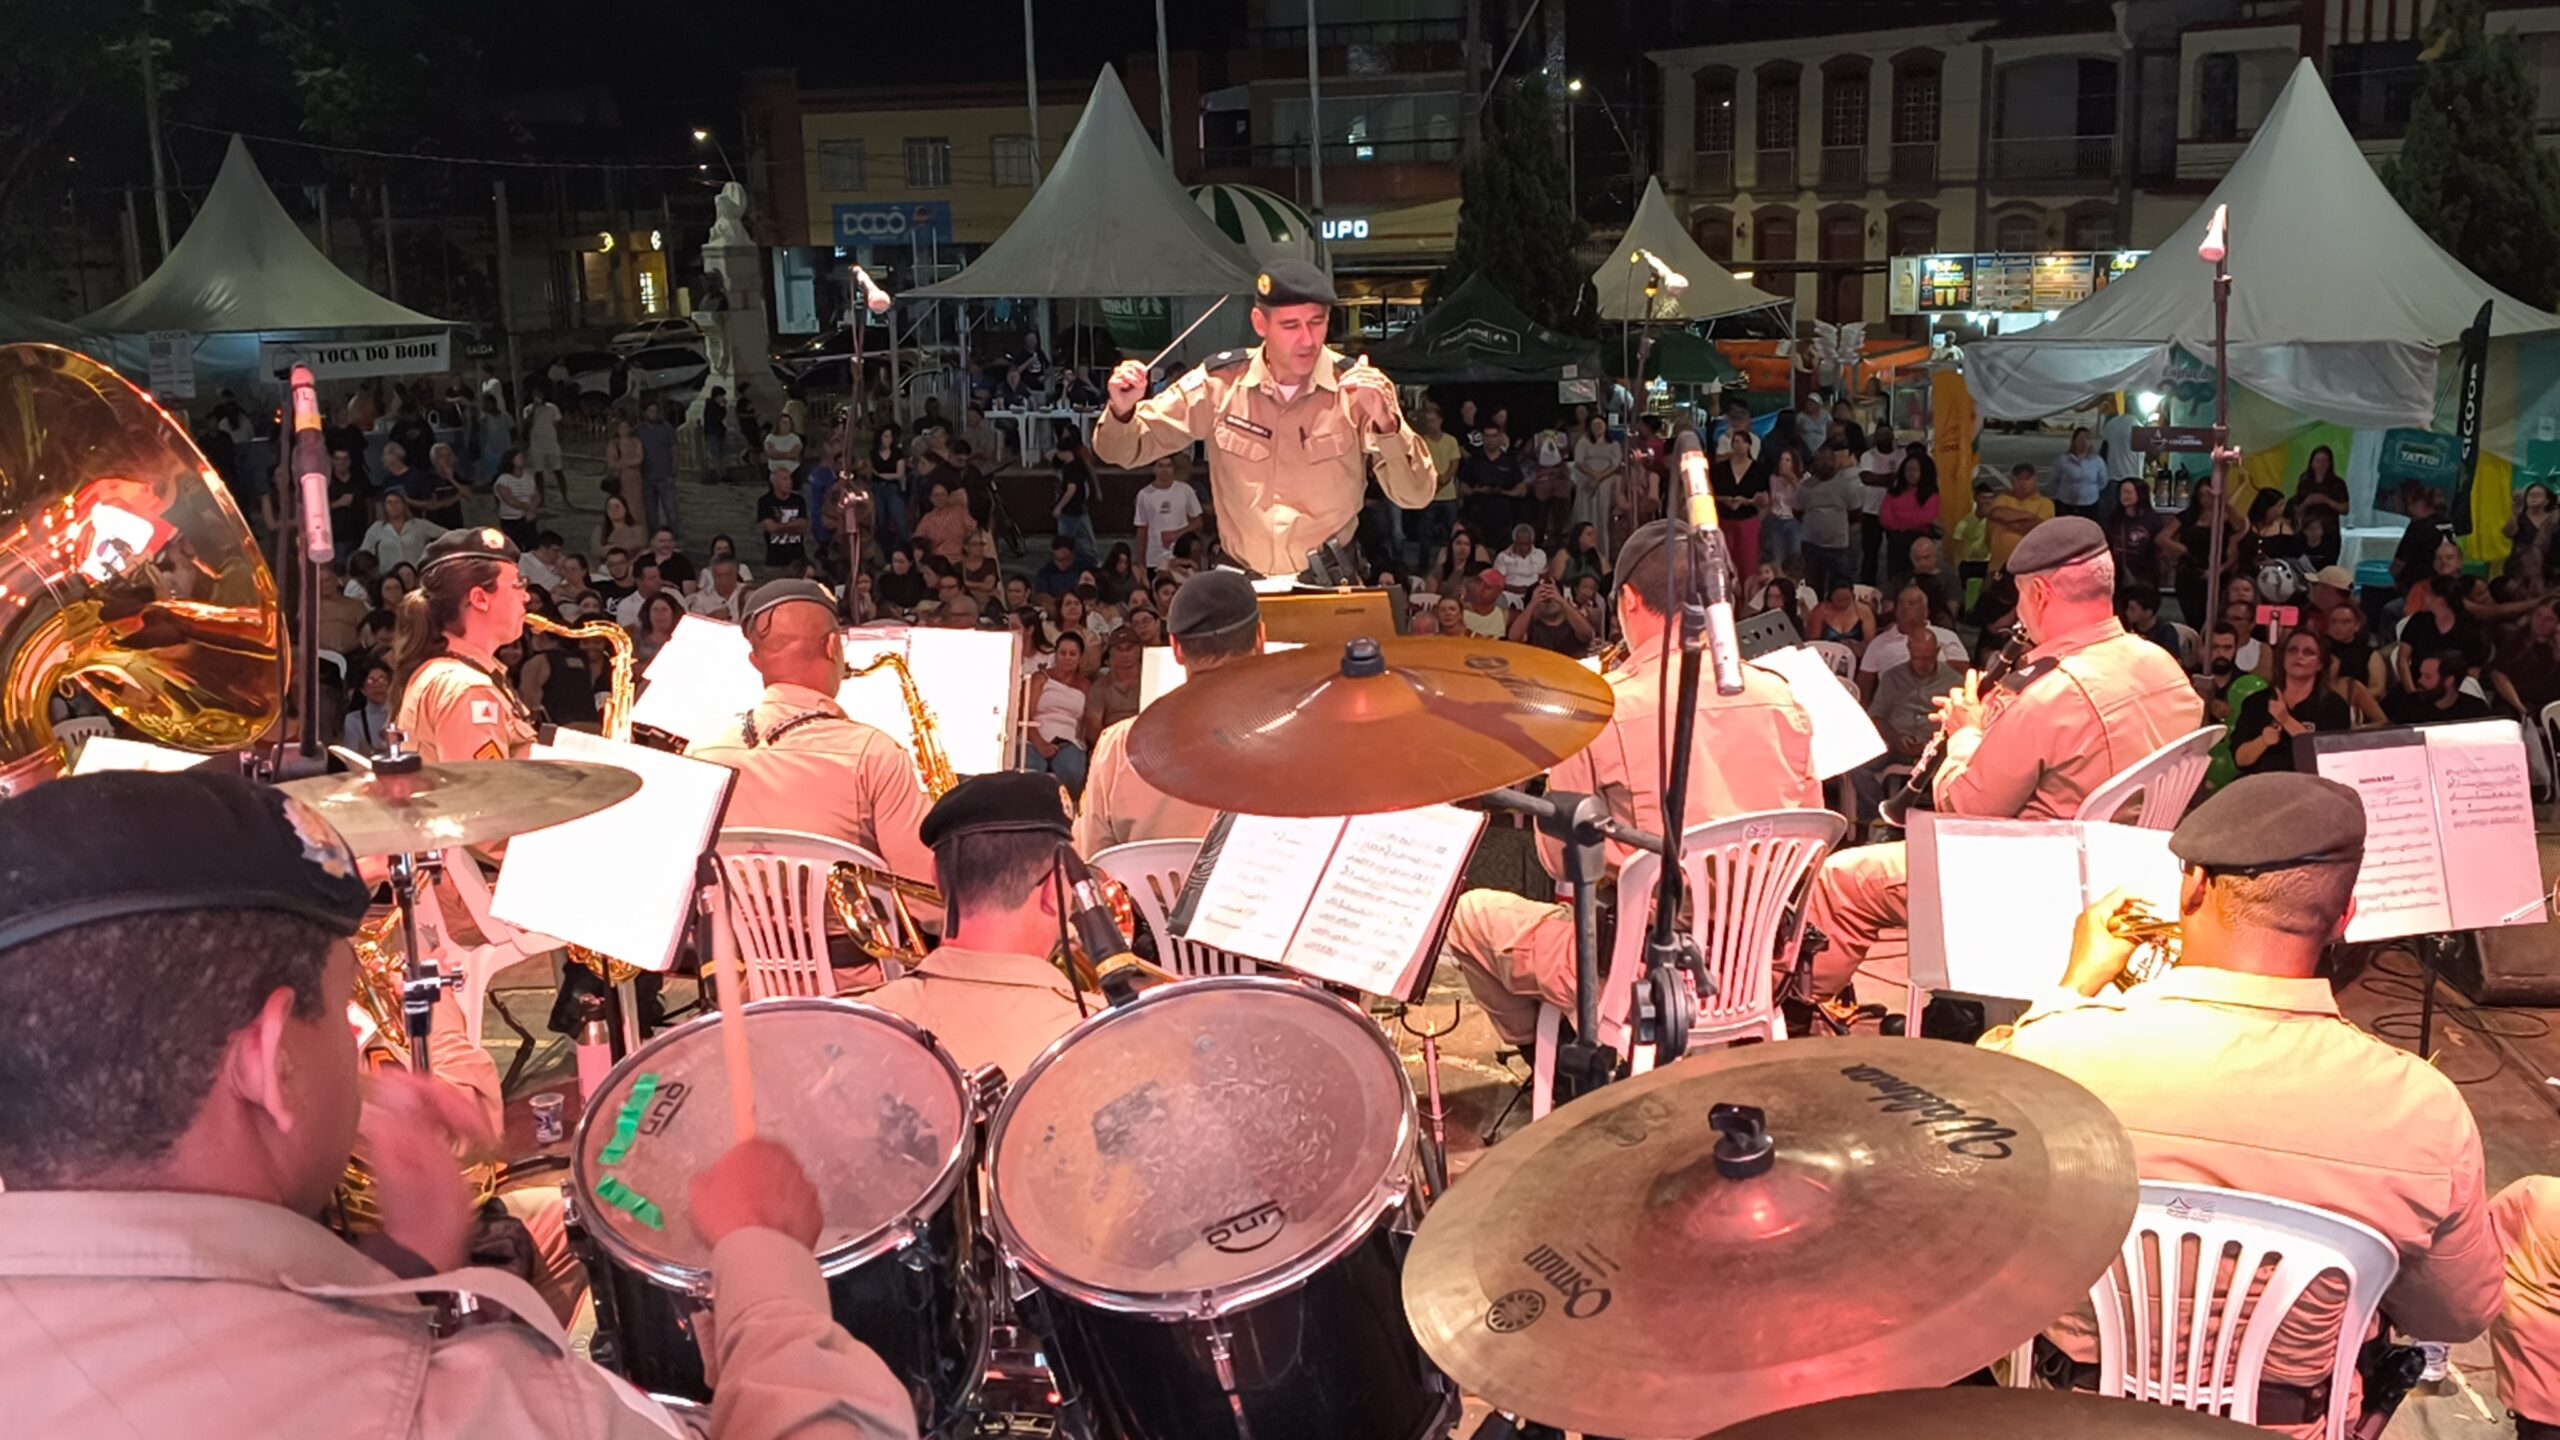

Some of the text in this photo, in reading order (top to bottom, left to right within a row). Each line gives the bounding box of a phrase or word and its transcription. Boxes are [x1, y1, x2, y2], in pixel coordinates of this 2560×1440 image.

[318, 343, 440, 364] TOCA DO BODE
[1522, 1243, 1612, 1319] Osman
